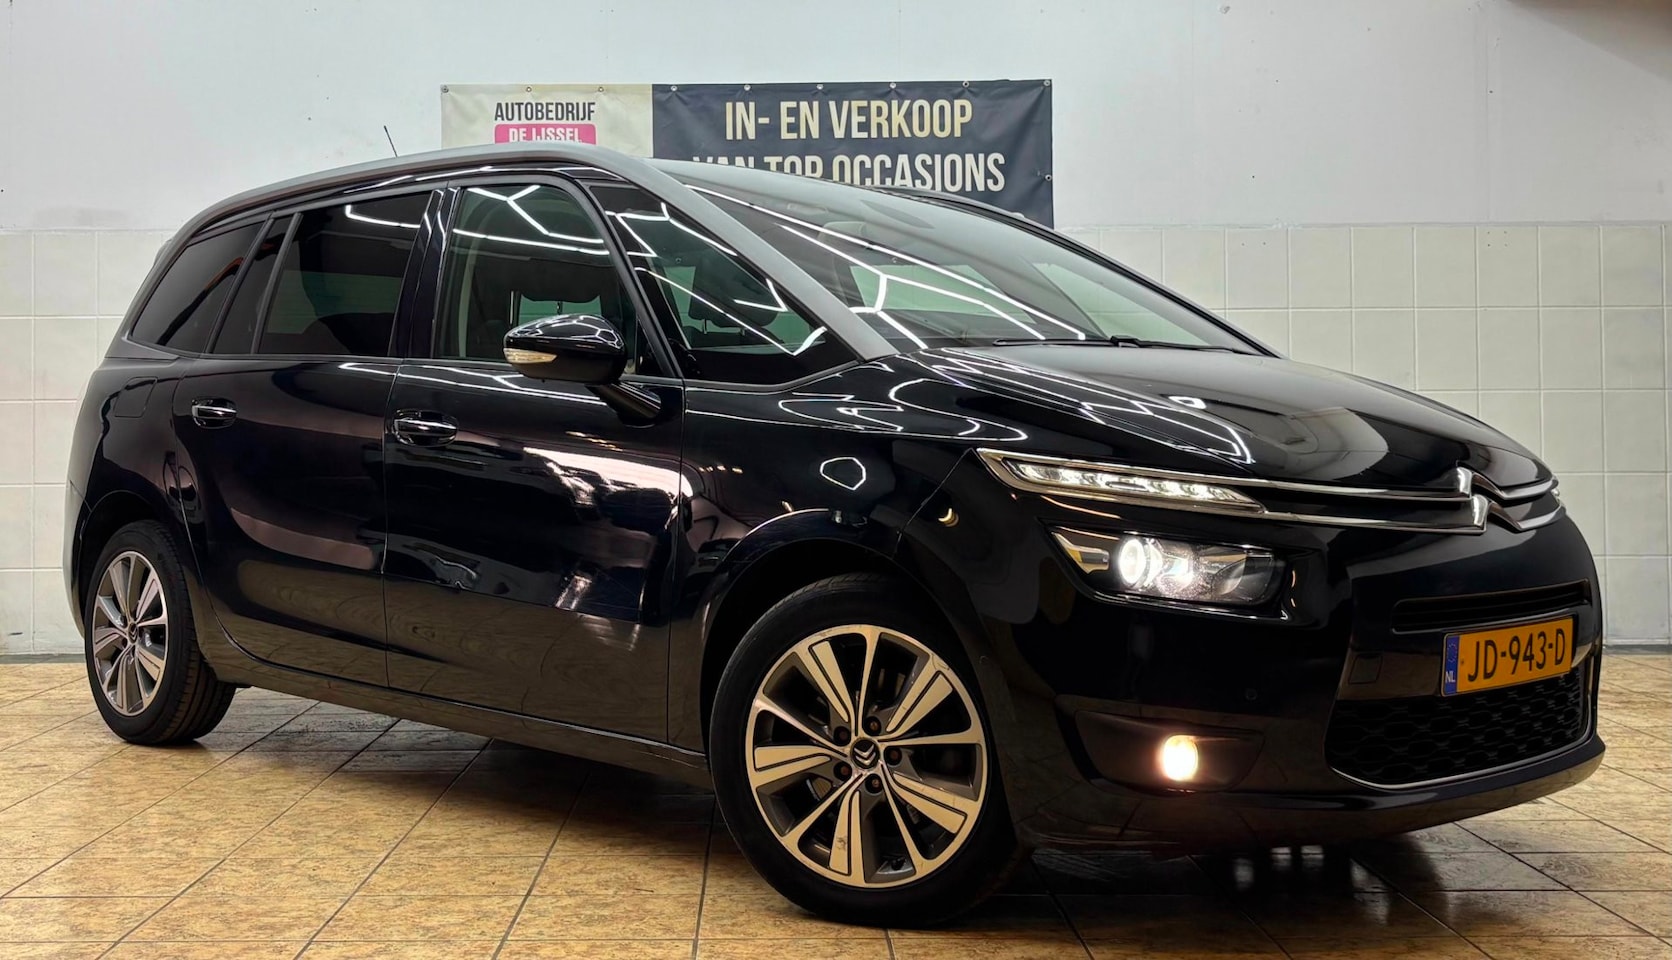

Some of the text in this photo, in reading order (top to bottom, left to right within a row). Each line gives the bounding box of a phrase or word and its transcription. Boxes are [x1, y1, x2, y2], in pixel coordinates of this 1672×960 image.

[494, 102, 596, 121] AUTOBEDRIJF
[725, 99, 973, 140] IN- EN VERKOOP
[509, 128, 527, 143] DE
[832, 152, 1006, 192] OCCASIONS
[1467, 628, 1566, 682] JD-943-D
[1445, 671, 1456, 683] NL
